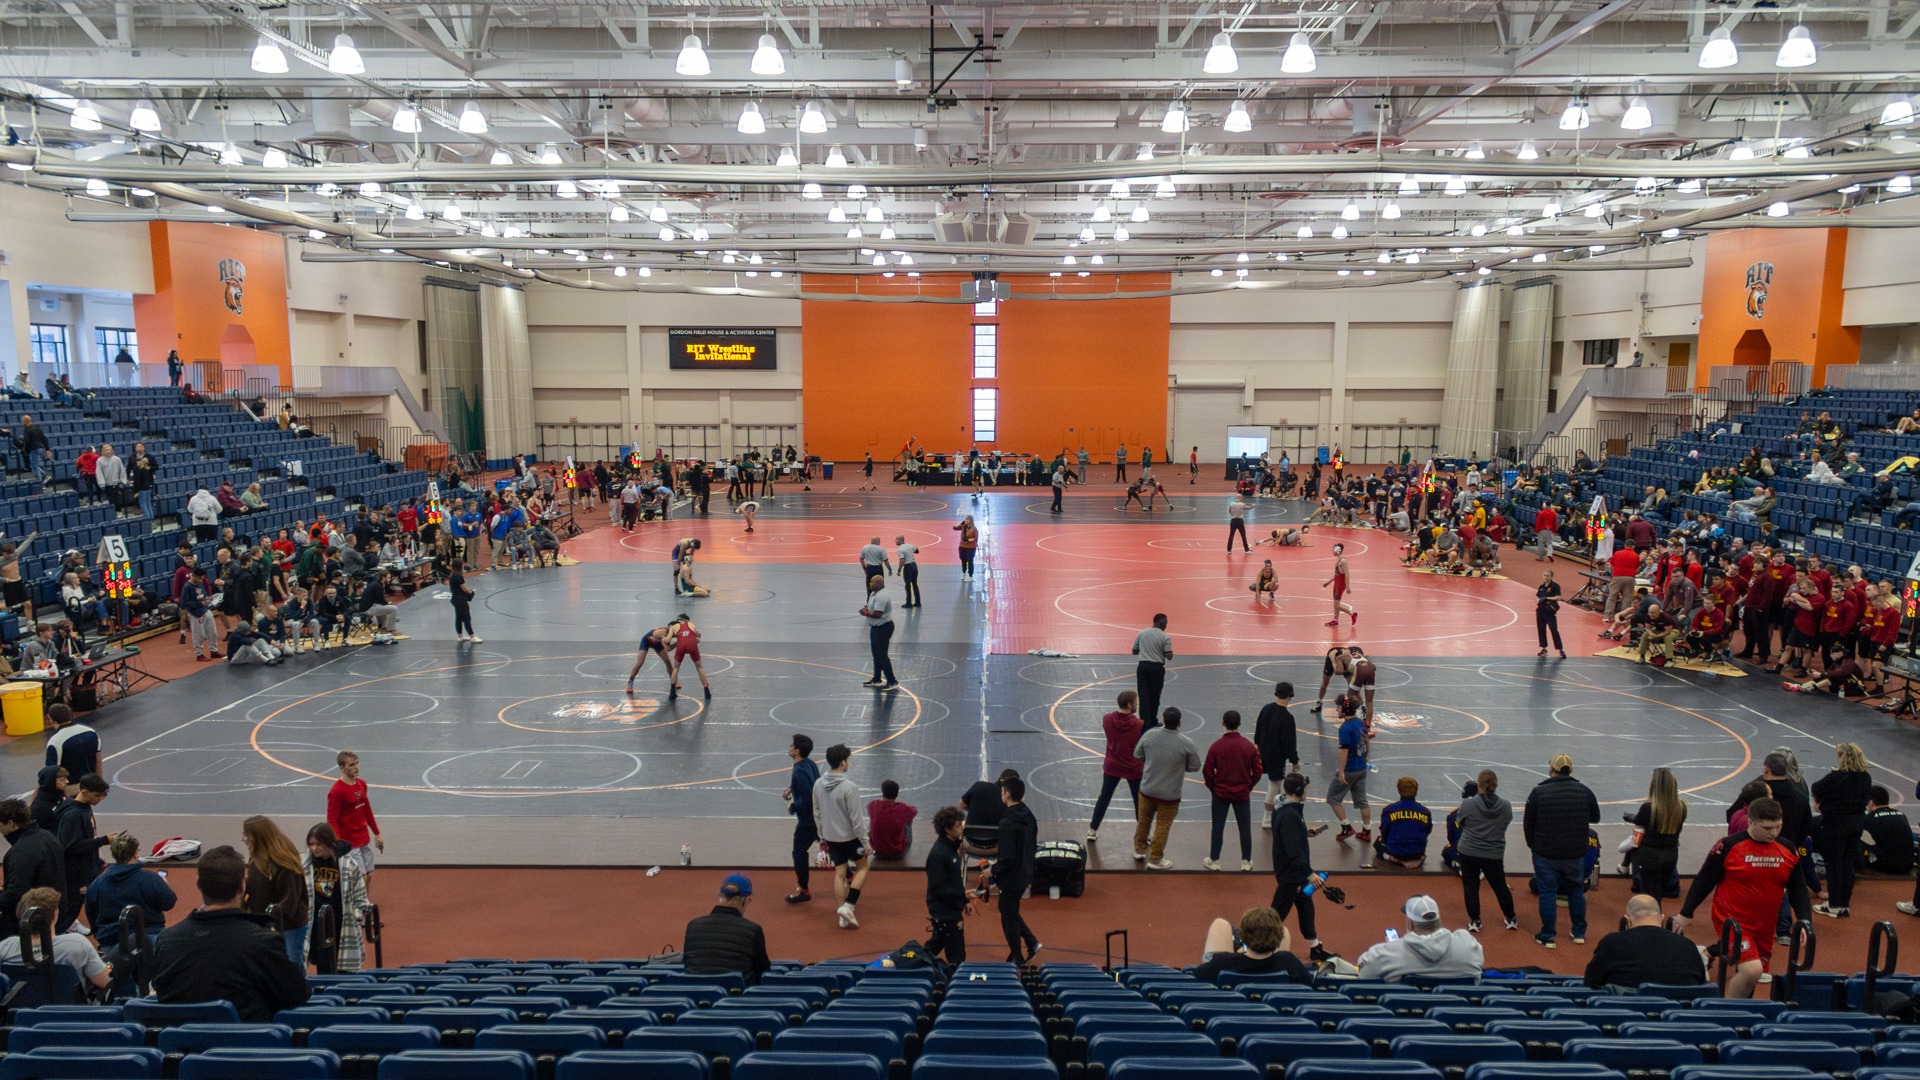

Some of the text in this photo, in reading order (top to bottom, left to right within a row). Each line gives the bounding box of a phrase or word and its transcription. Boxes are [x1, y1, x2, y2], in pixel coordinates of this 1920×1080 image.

[219, 258, 246, 283] RIT
[1745, 261, 1774, 290] RIT
[686, 344, 705, 353] RIT
[694, 352, 752, 361] Invitational
[111, 539, 124, 558] 5
[1390, 810, 1429, 824] WILLIAMS
